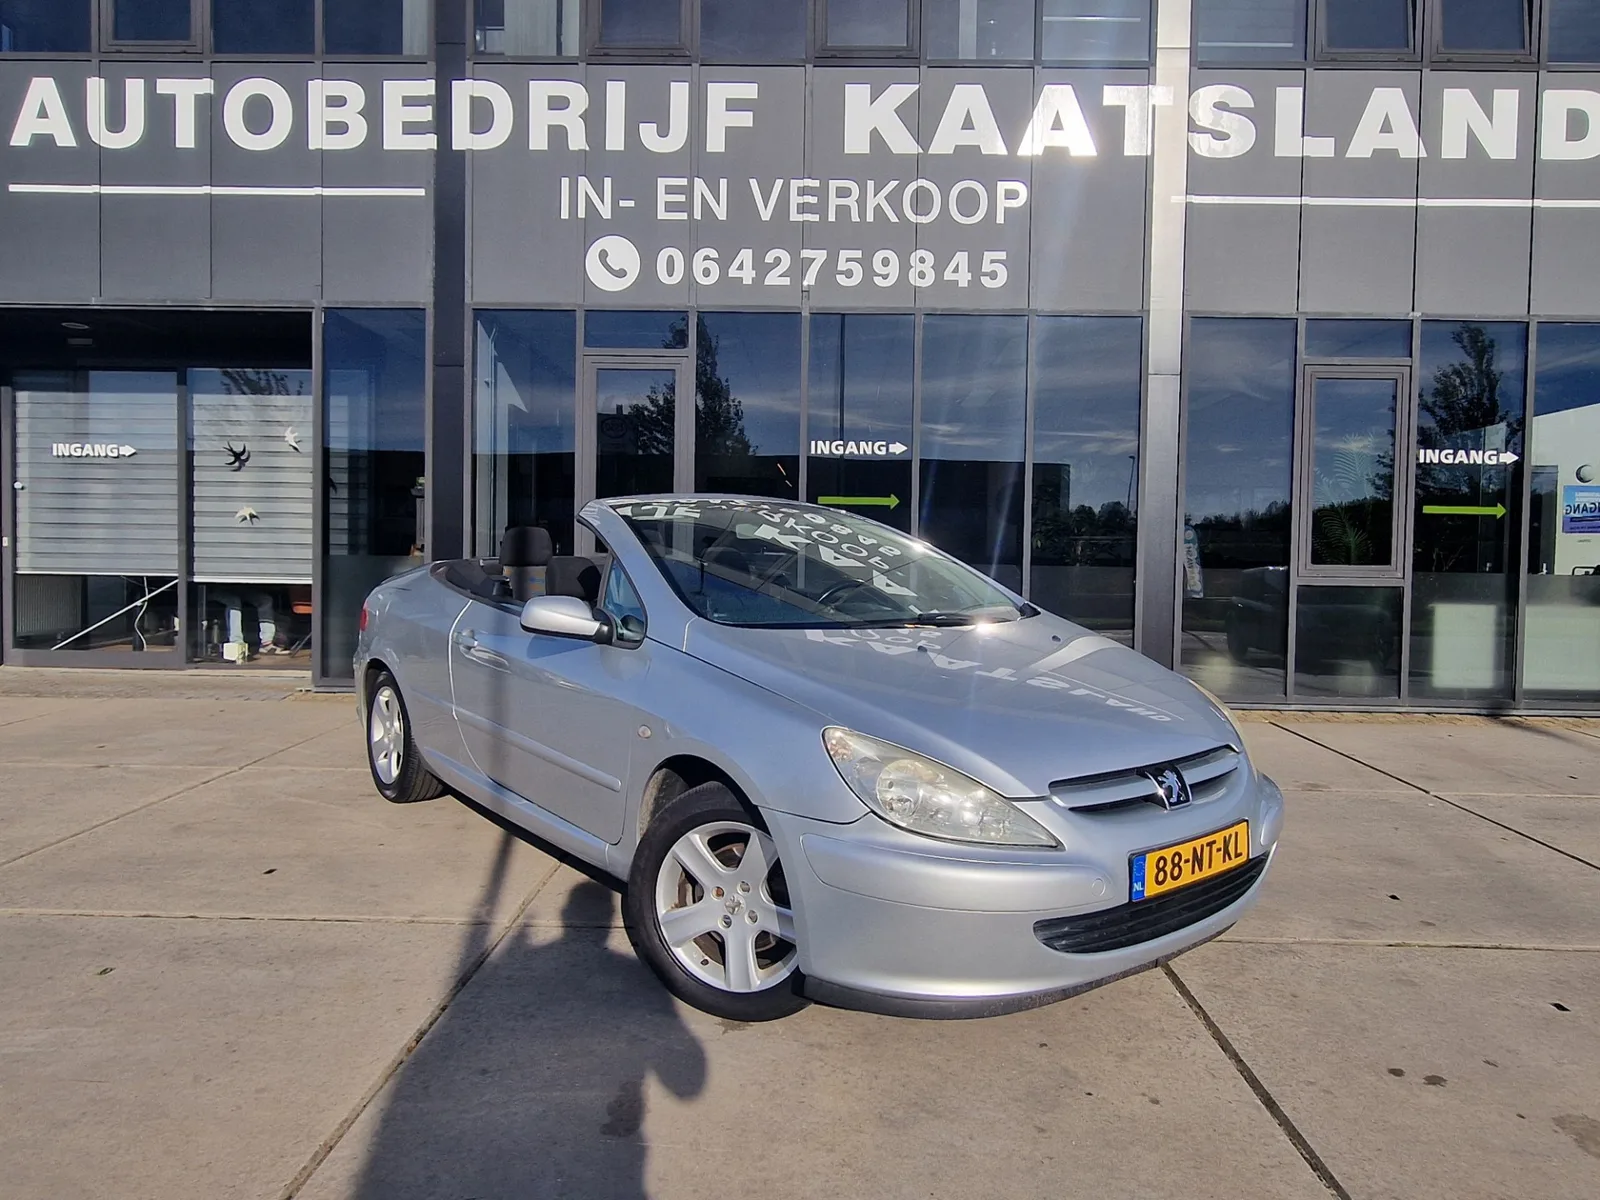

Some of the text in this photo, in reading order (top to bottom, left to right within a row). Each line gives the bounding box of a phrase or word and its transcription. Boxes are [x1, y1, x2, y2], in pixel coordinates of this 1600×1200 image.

[9, 76, 1600, 160] AUTOBEDRIJF KAATSLAND
[560, 176, 1028, 224] IN- EN VERKOOP
[656, 246, 1008, 288] 0642759845
[52, 443, 119, 457] INGANG
[810, 440, 887, 455] INGANG
[1419, 448, 1498, 465] INGANG
[1154, 830, 1243, 886] 88-NT-KL
[1133, 881, 1144, 892] NL
